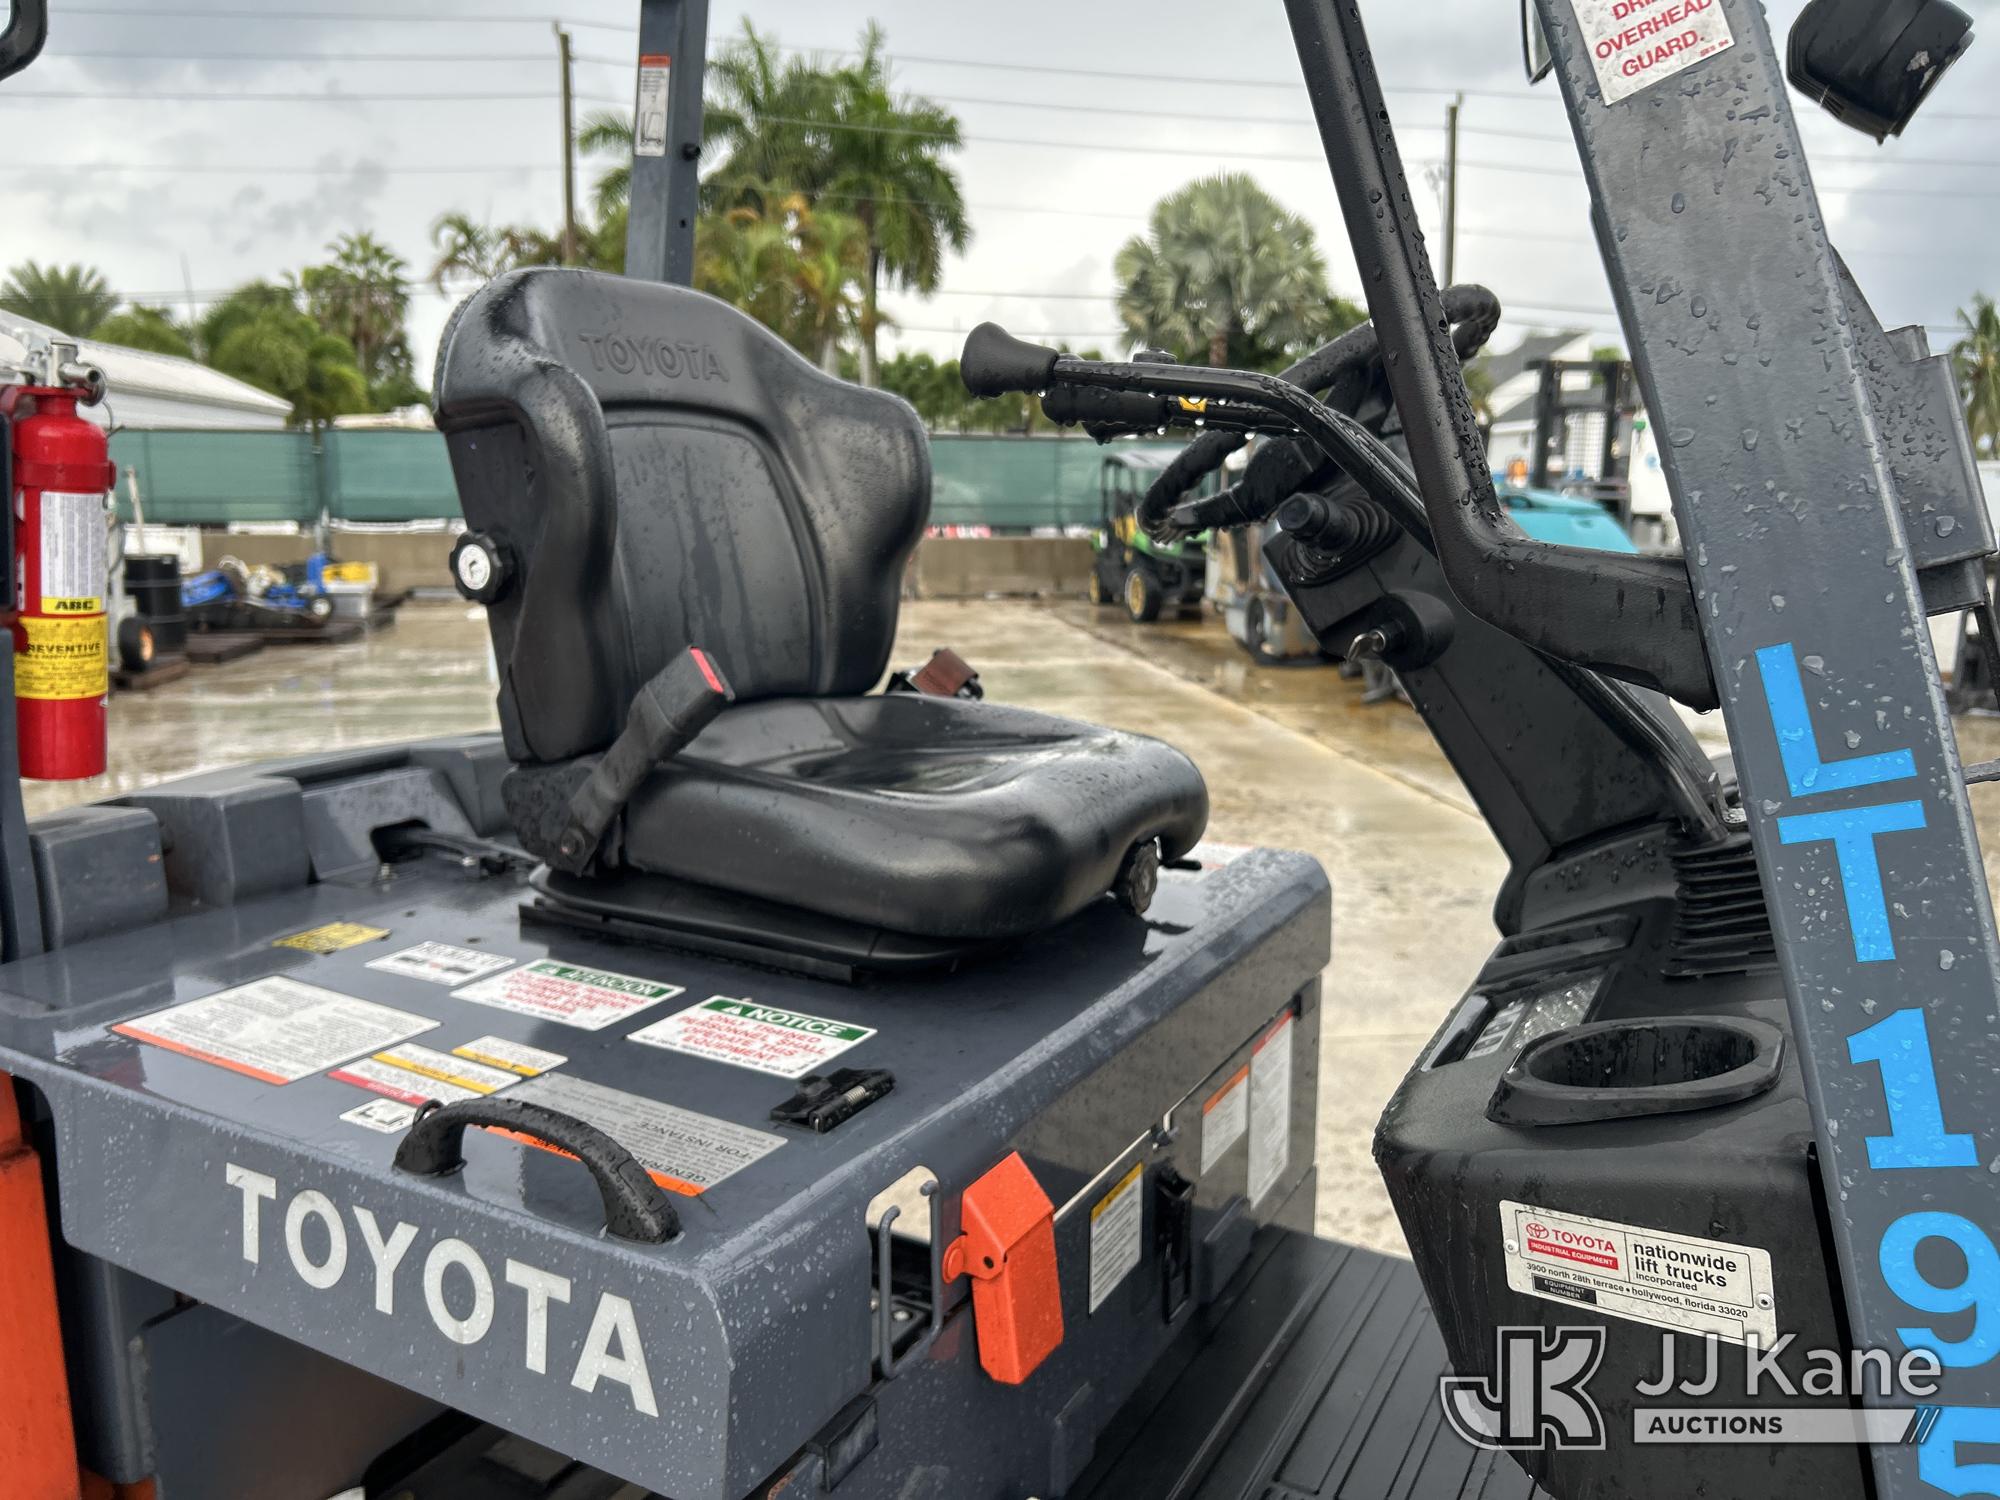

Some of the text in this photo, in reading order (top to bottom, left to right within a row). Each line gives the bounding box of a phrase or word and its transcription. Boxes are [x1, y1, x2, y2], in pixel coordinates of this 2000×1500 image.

[1595, 0, 1712, 59] OVERHEAD
[577, 332, 730, 383] TOYOTA
[745, 1008, 848, 1036] NOTICE
[1531, 1242, 1614, 1265] INDUSTRIAL EQUIPMENT
[1551, 1228, 1617, 1253] TOYOTA
[1633, 1243, 1737, 1272] nationwide
[1635, 1256, 1727, 1287] lift trucks
[226, 1162, 659, 1418] TOYOTA
[1526, 1262, 1547, 1273] 3900
[1548, 1268, 1570, 1279] north
[1572, 1273, 1591, 1284] 28th
[1593, 1277, 1624, 1292] terrace
[1684, 1298, 1716, 1312] florida
[1718, 1305, 1749, 1318] 33020
[1544, 1279, 1585, 1294] EQUIPMENT
[1550, 1287, 1581, 1299] NUMBER
[1636, 1272, 1698, 1291] incorporated
